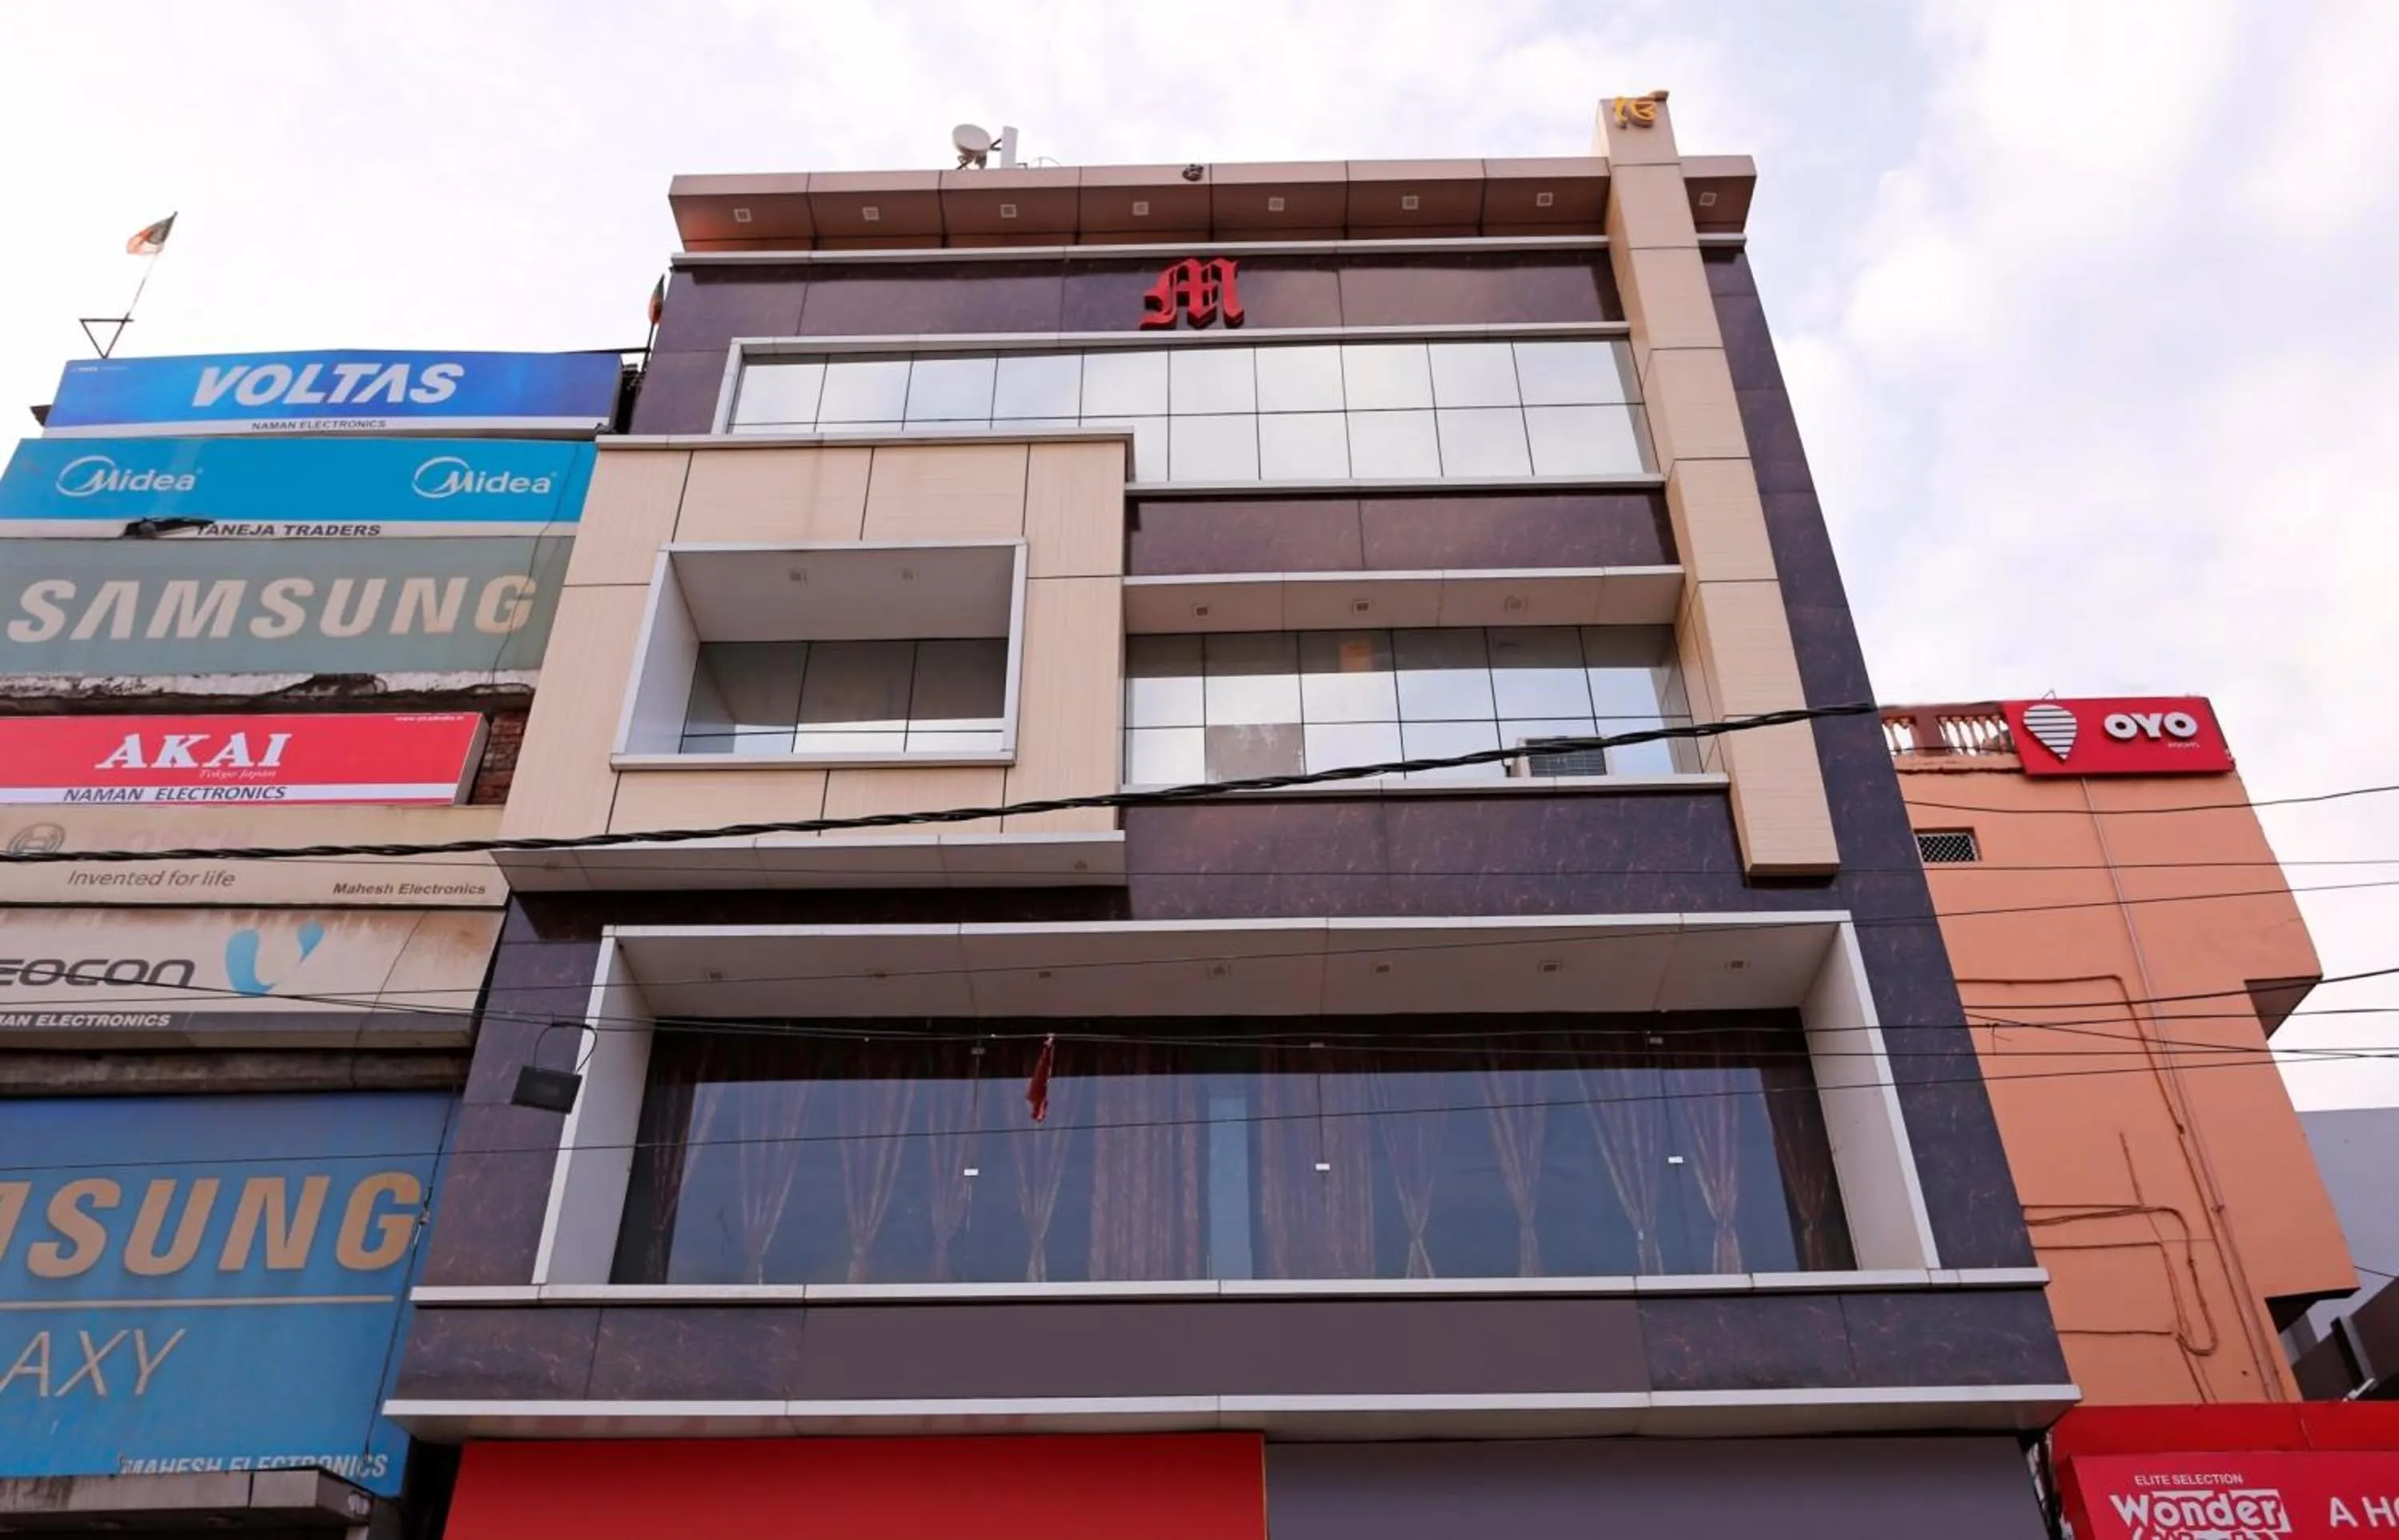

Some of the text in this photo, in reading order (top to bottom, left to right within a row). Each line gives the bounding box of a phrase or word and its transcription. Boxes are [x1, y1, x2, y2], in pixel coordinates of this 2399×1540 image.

[192, 363, 464, 407] VOLTAS
[251, 420, 387, 430] NAMAN ELECTRONICS
[67, 461, 195, 495] Midea
[421, 461, 550, 495] Midea
[283, 524, 381, 536] TRADERS
[7, 575, 537, 641] SAMSUNG
[2104, 712, 2197, 739] OYO
[95, 732, 292, 769] AKAI
[63, 786, 287, 802] NAMAN ELECTRONICS
[67, 870, 237, 887] Invented for life
[333, 882, 486, 895] Mahesh Electronics
[36, 1014, 172, 1027] ELECTRONICS
[0, 1172, 422, 1278] SUNG
[2134, 1473, 2244, 1486] ELITE SELECTION
[2110, 1492, 2277, 1528] Wonder
[2329, 1496, 2399, 1528] A H
